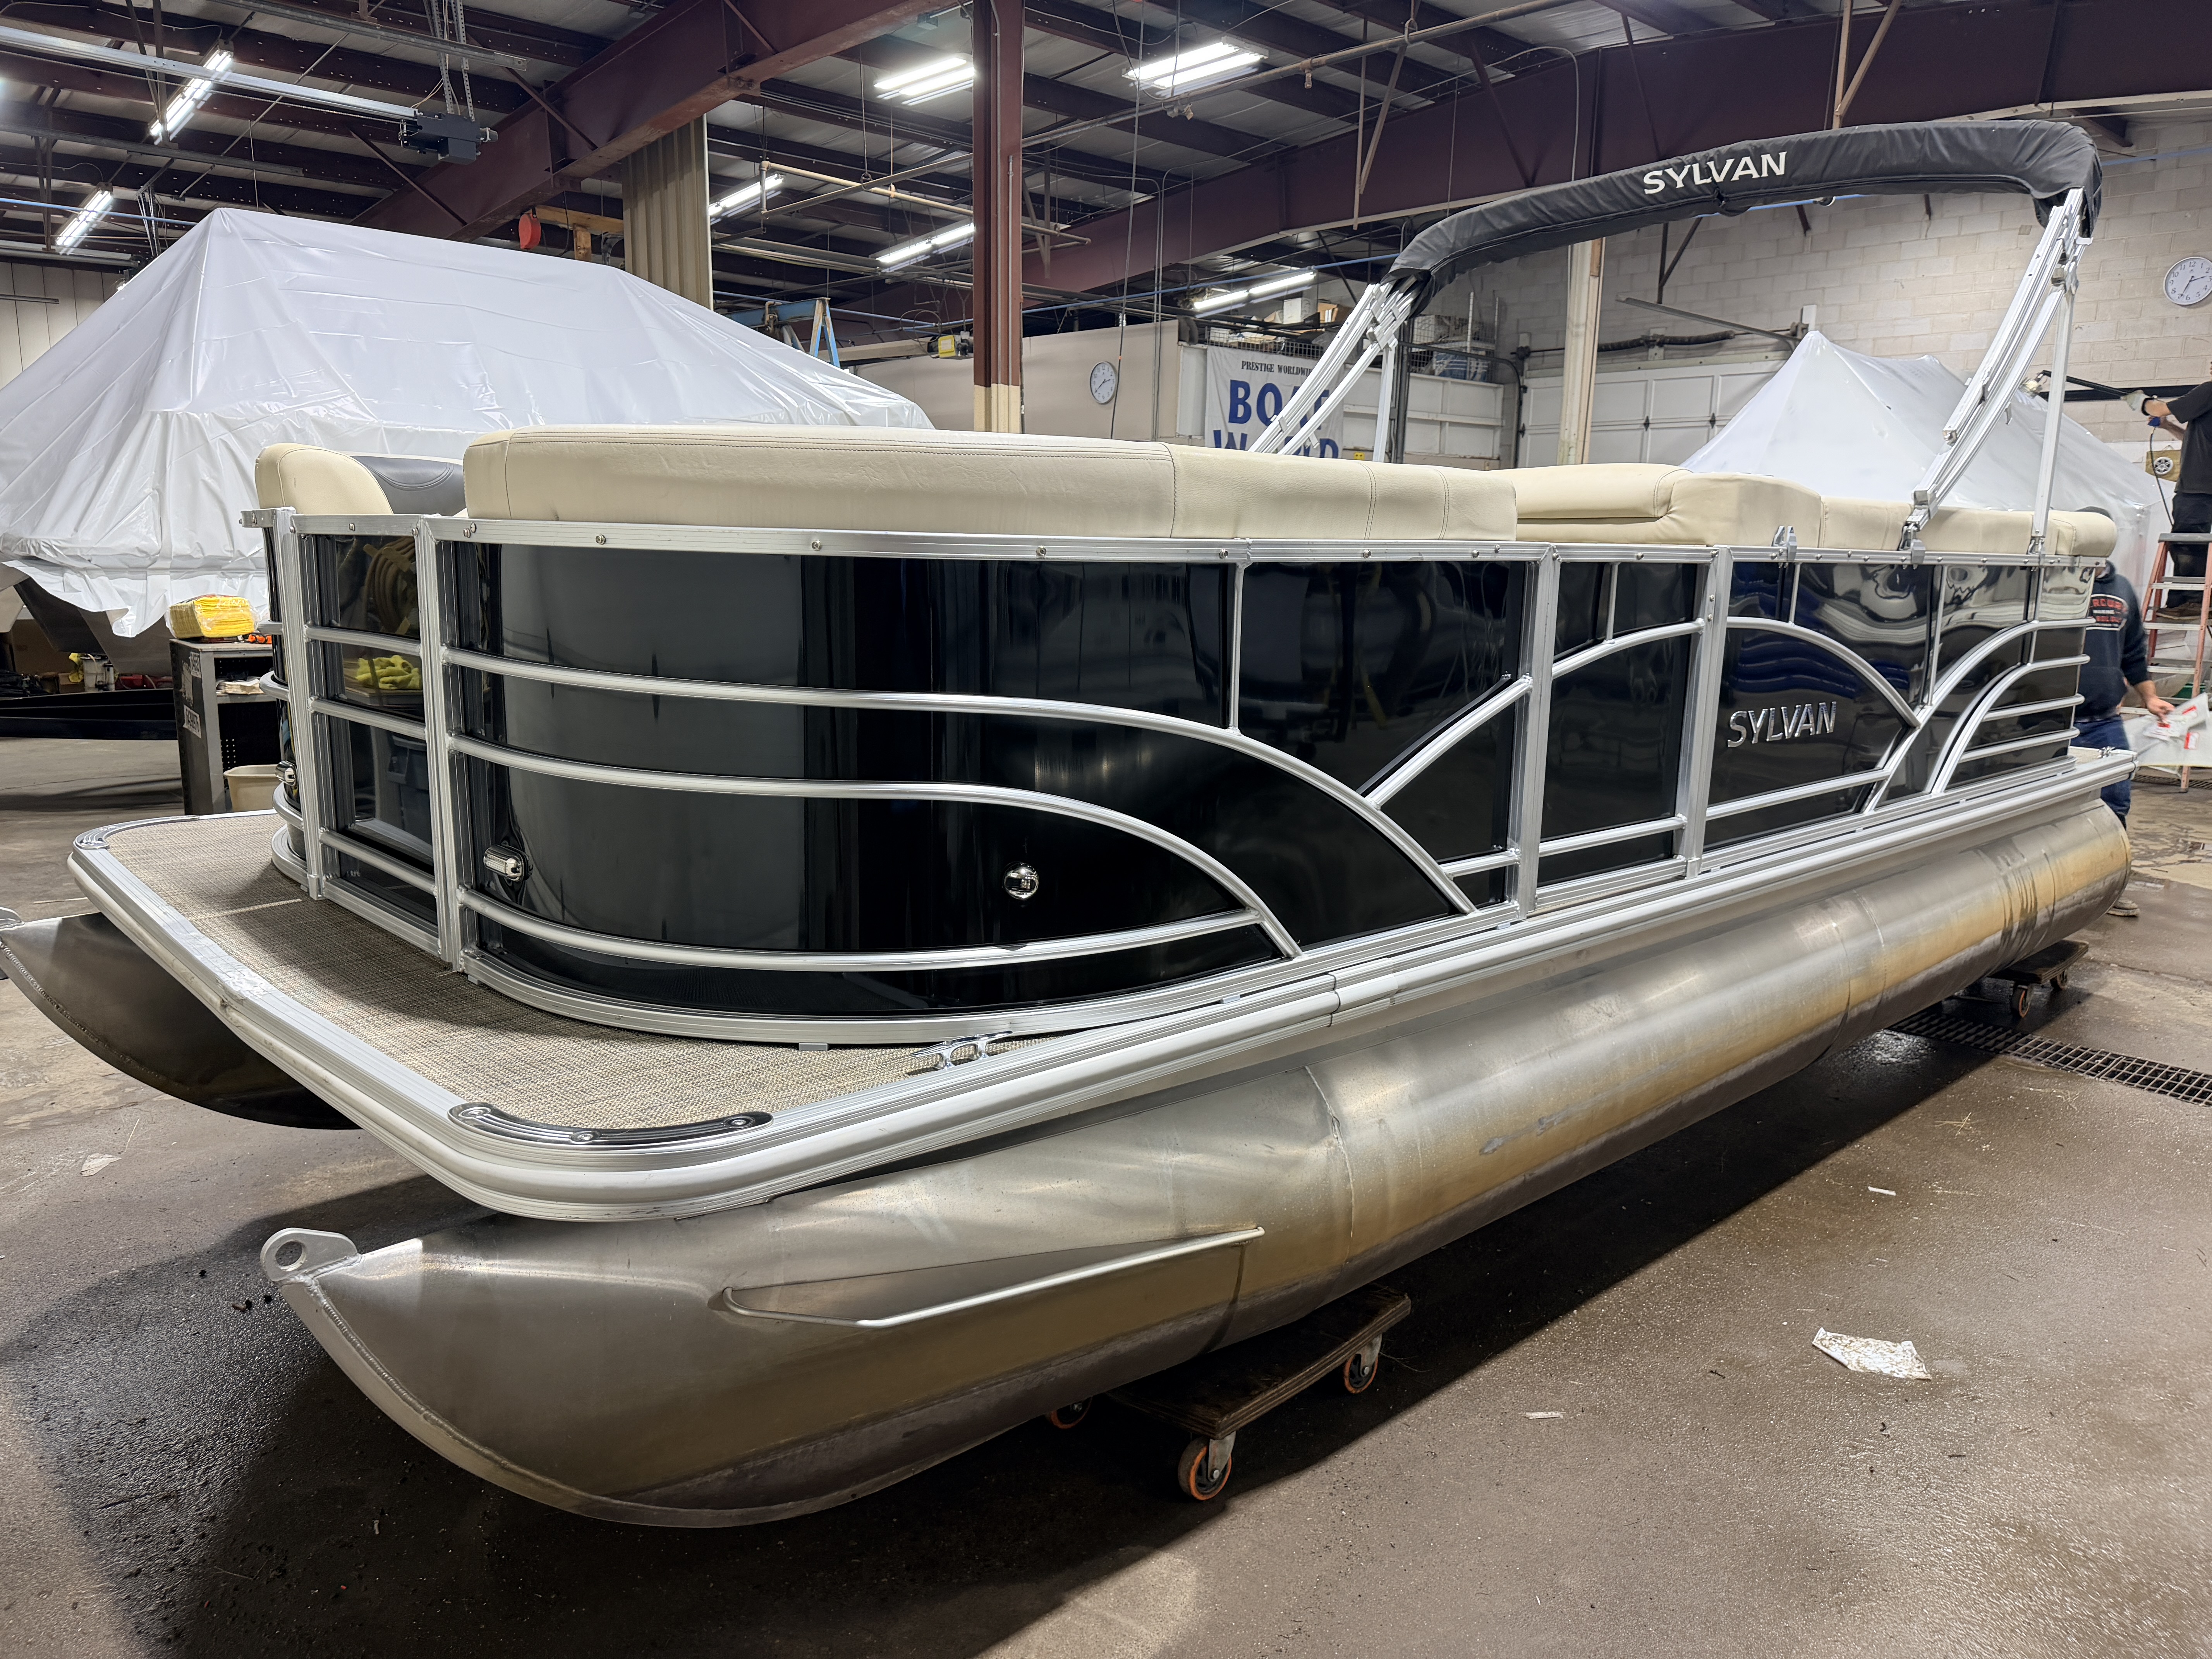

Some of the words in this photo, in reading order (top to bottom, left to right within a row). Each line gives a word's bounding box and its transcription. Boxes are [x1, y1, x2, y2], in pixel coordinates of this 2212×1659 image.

[1643, 151, 1787, 194] SYLVAN
[1242, 361, 1274, 373] PRESTIGE
[1727, 701, 1836, 747] SYLVAN
